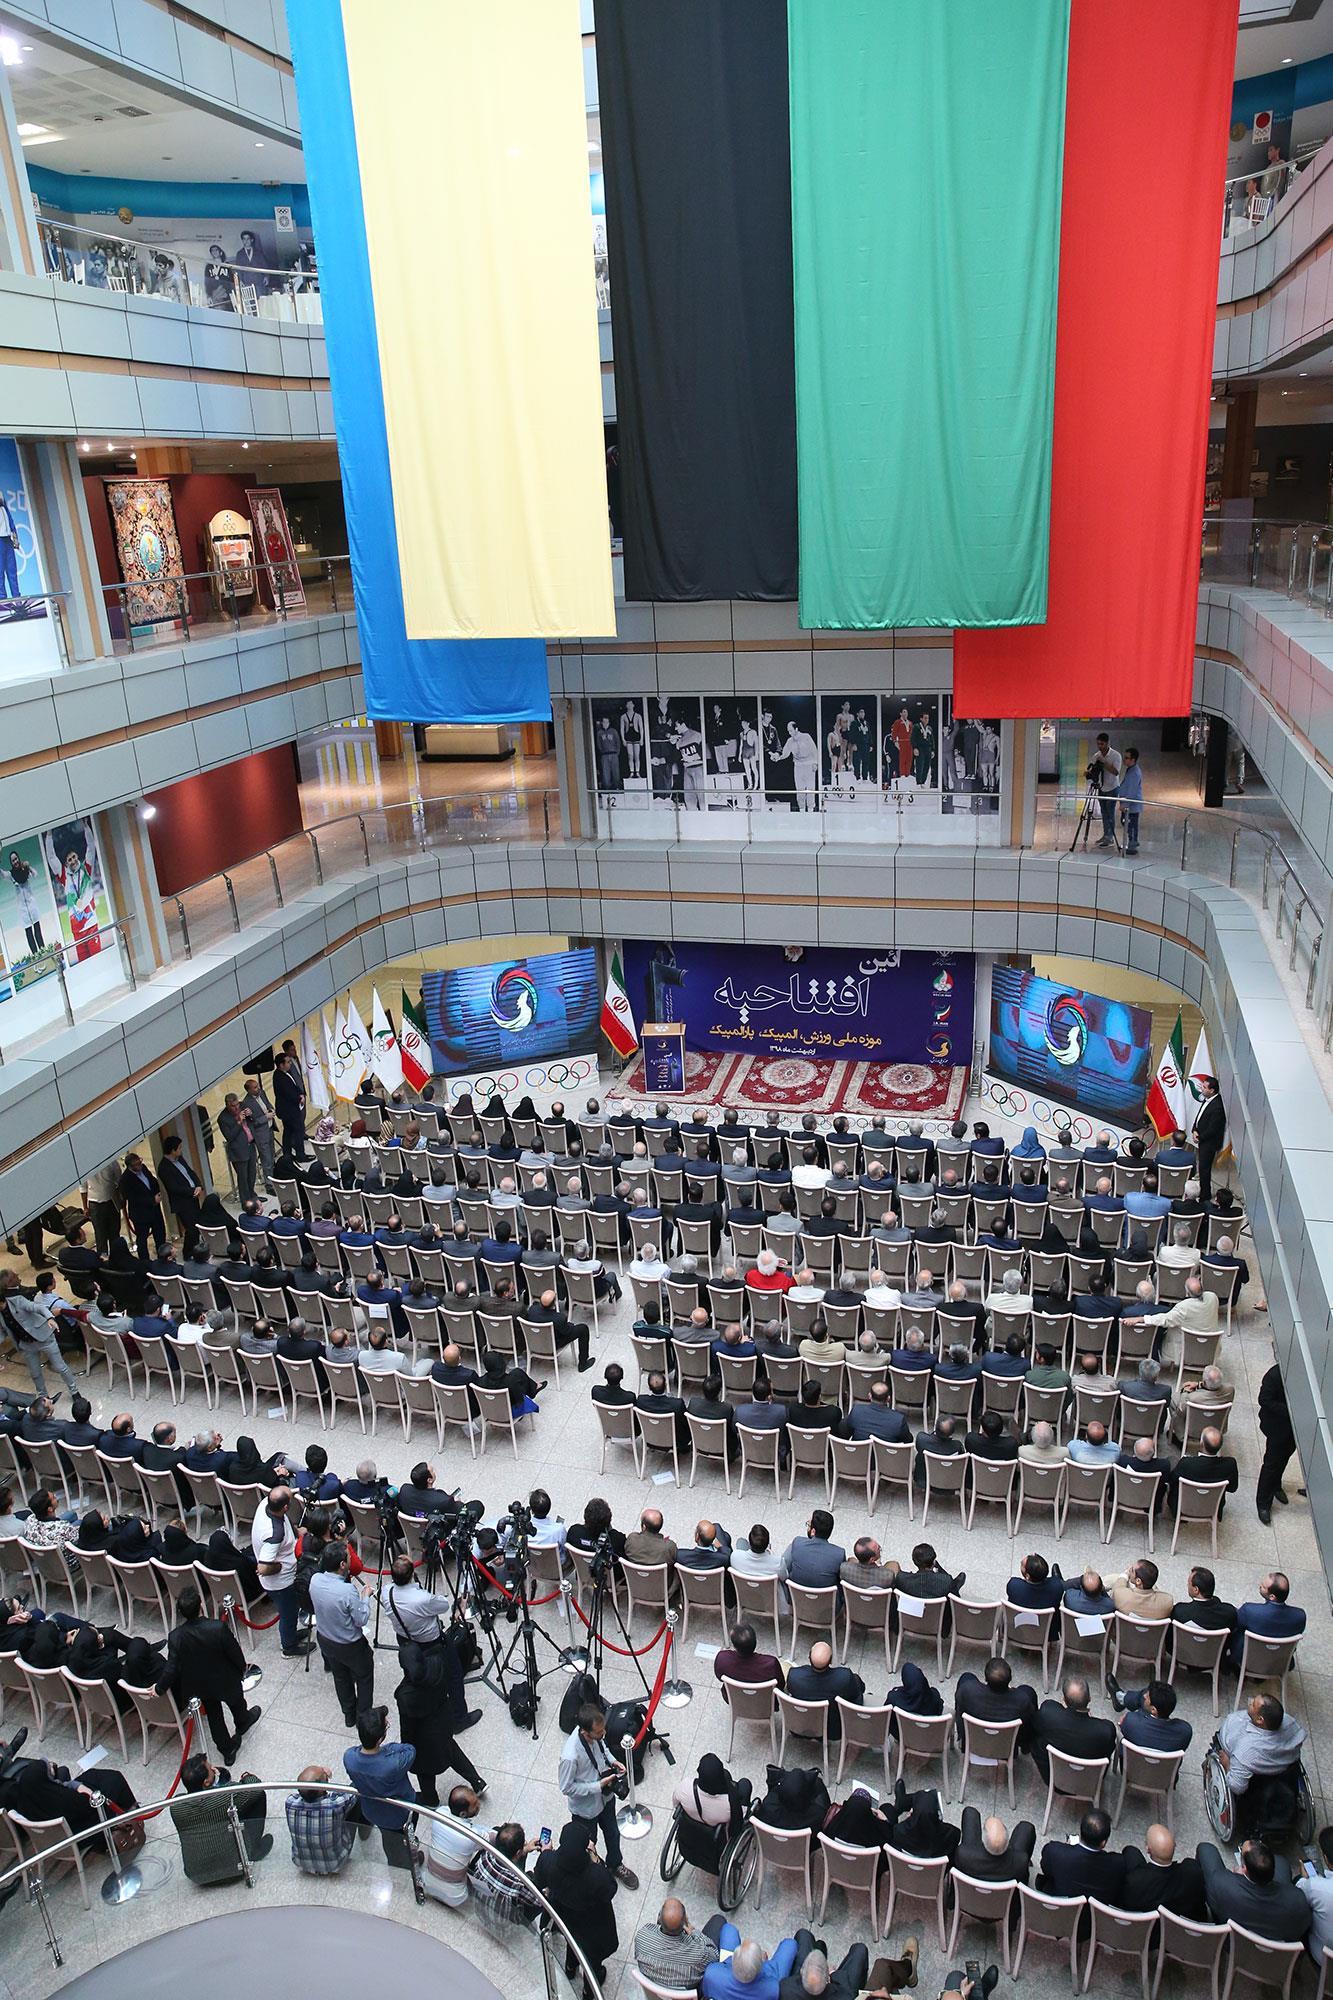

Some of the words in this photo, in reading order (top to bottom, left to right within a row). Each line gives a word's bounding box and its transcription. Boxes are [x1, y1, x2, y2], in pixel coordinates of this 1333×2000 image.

[713, 972, 870, 1025] افتتاحیه
[709, 1025, 755, 1040] پارالمپیک
[832, 1032, 858, 1047] ملی
[859, 1033, 882, 1049] موزه
